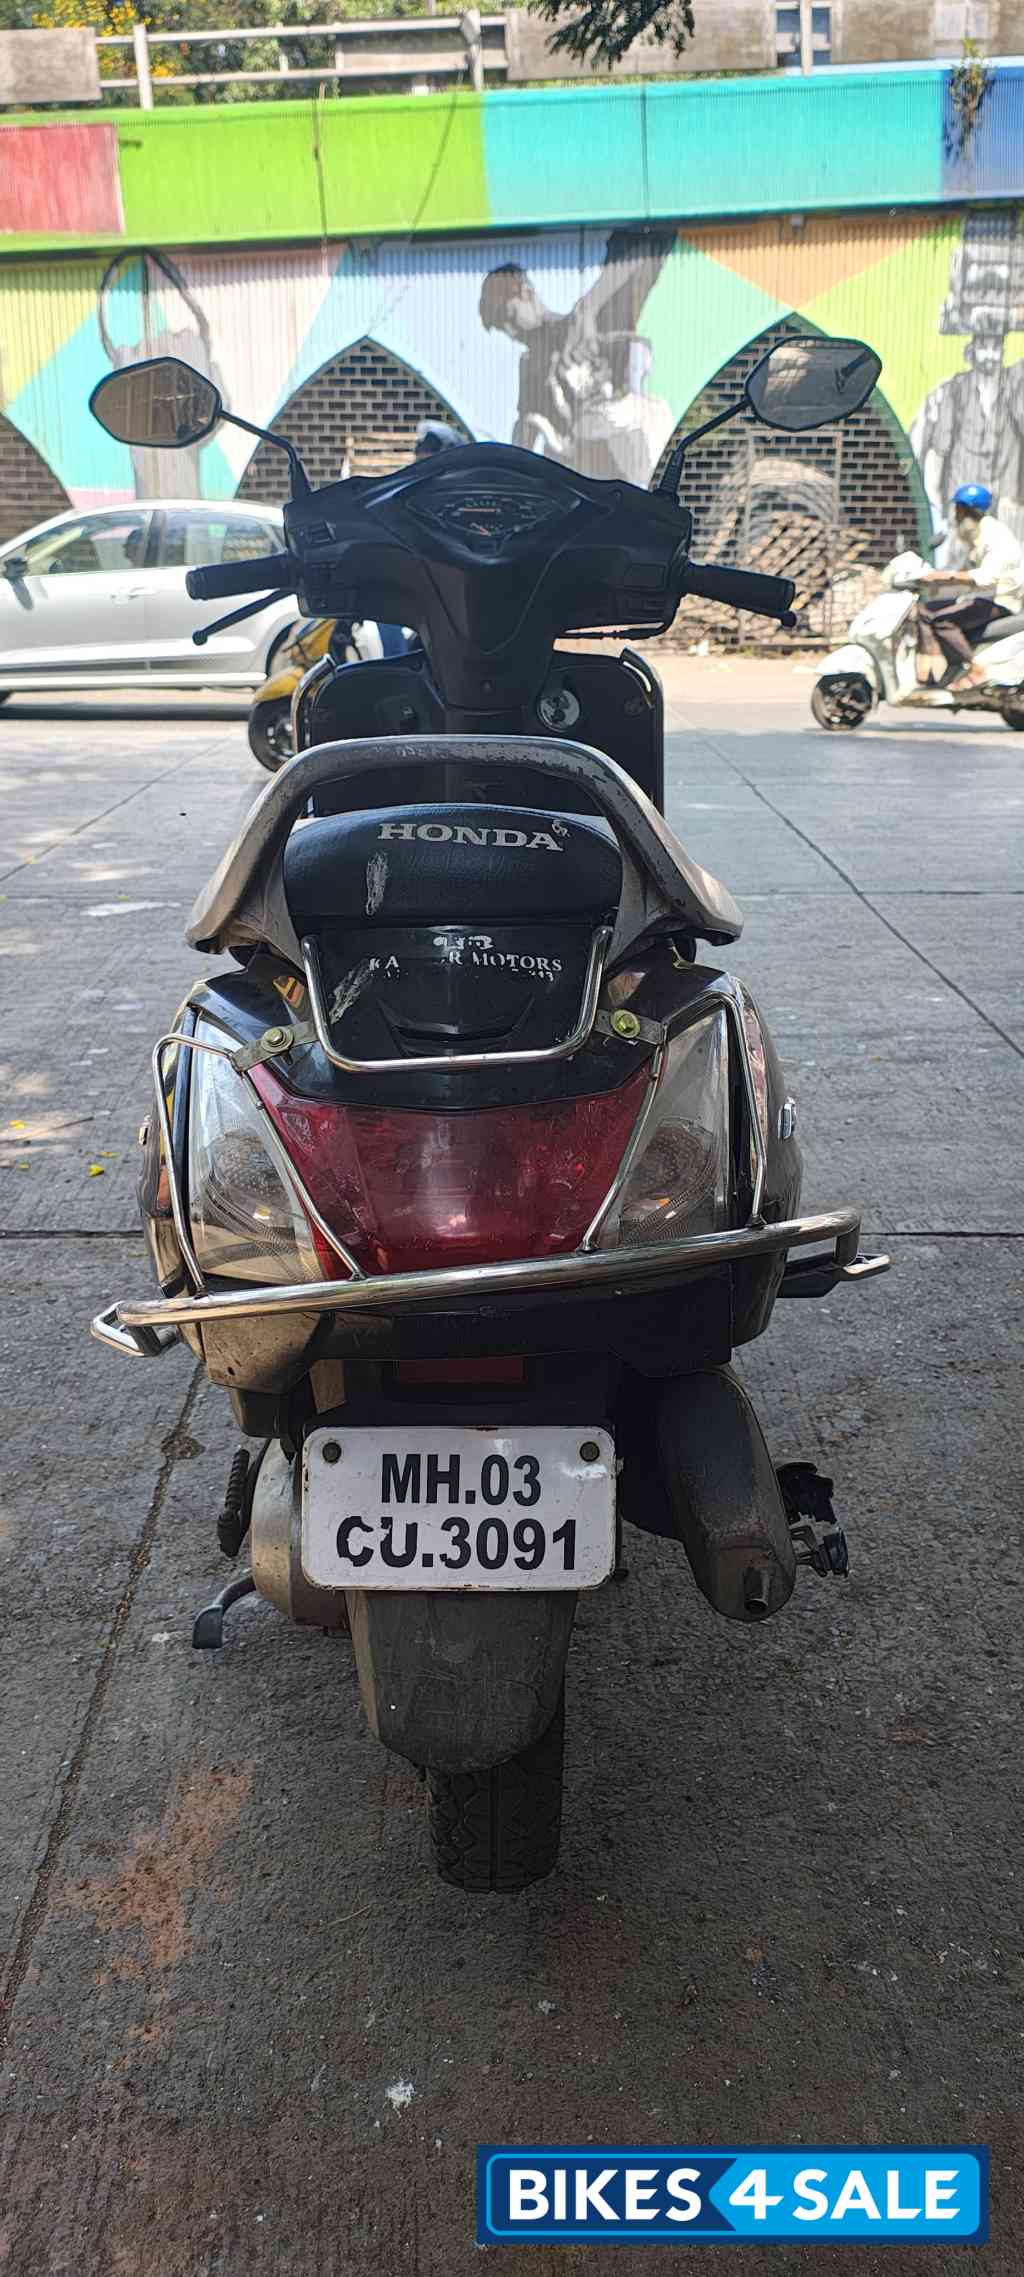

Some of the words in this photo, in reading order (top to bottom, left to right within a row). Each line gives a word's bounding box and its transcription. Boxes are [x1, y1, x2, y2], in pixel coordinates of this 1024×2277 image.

[377, 822, 564, 851] HONDA
[472, 951, 562, 972] MOTORS
[380, 1453, 542, 1506] MH.03
[336, 1515, 577, 1570] CU.3091
